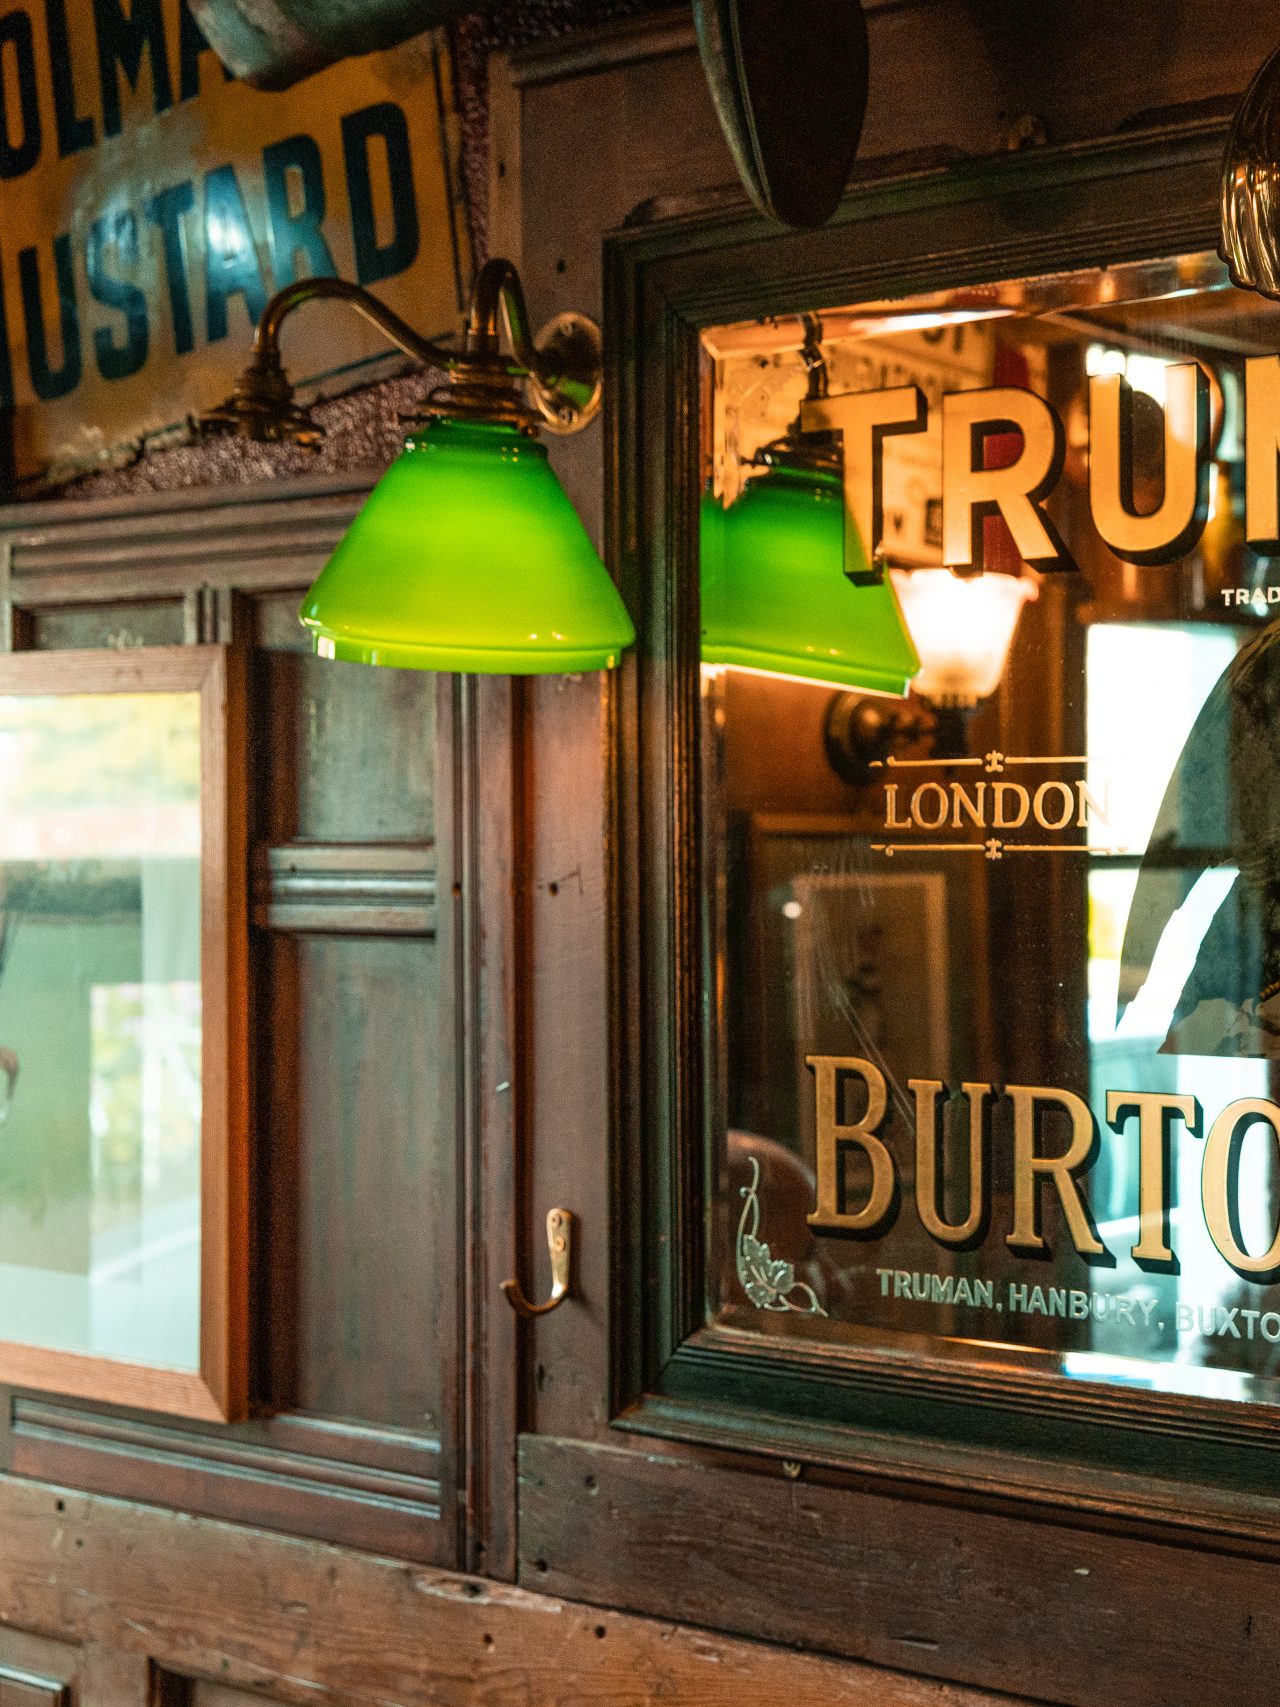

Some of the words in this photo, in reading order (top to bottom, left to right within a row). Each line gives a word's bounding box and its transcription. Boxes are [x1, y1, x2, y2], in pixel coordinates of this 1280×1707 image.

[0, 102, 422, 412] USTARD
[883, 780, 1112, 830] LONDON
[875, 1268, 1003, 1313] TRUMAN,
[1008, 1282, 1166, 1331] HANBURY,
